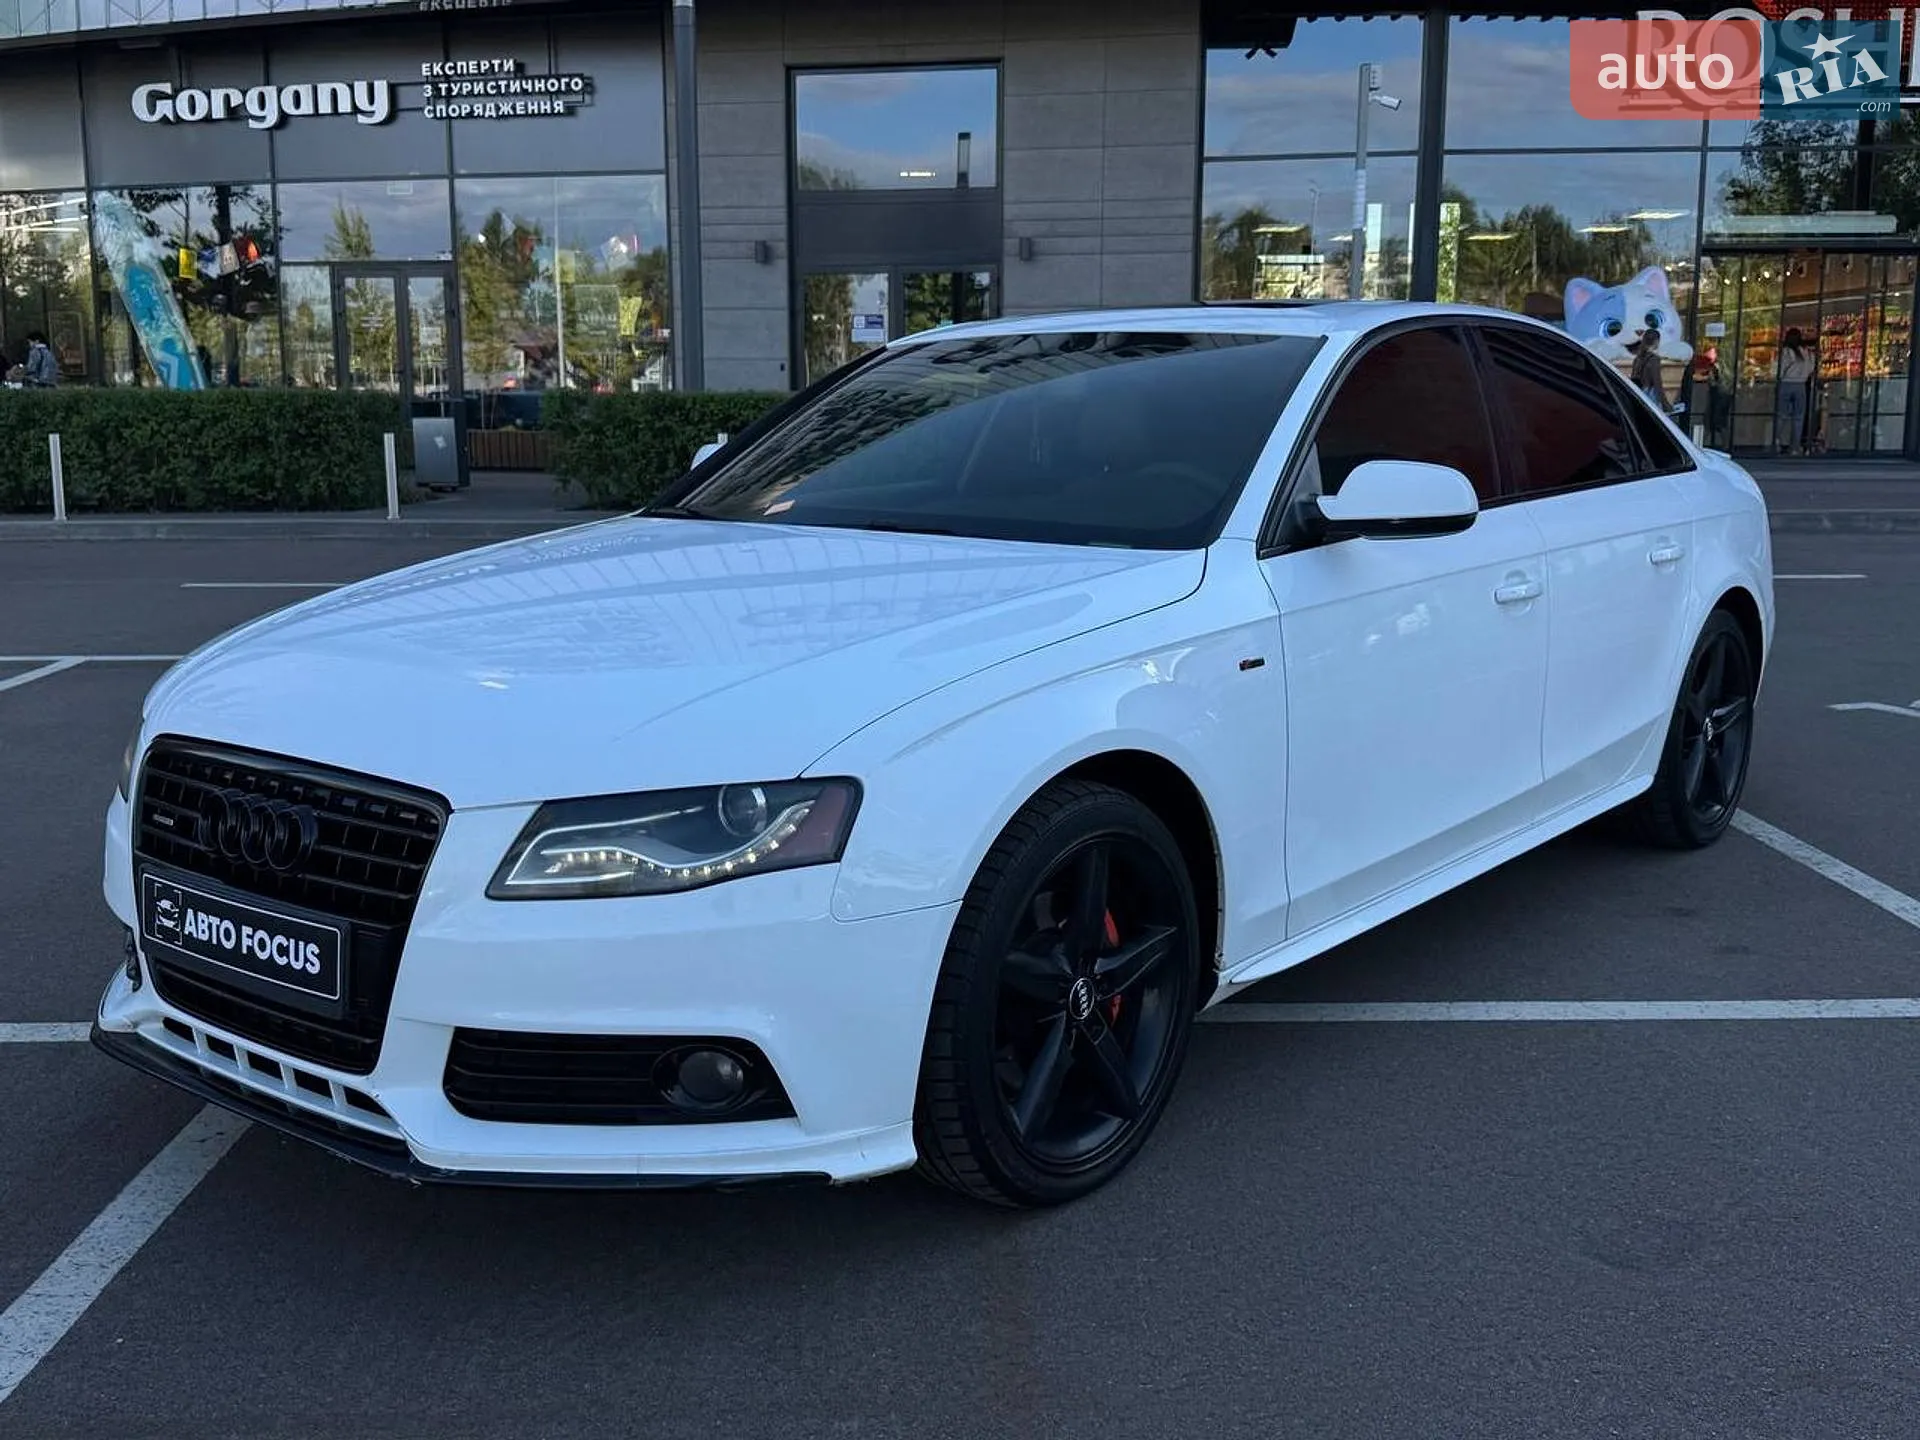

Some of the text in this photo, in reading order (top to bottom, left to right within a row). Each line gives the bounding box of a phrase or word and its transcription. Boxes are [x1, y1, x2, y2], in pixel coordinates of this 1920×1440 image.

[421, 58, 516, 77] ЕКСПЕРТИ
[438, 76, 584, 97] ТУРИСТИЧНОГО
[131, 79, 390, 129] Gorgany
[424, 100, 566, 119] СПОРЯДЖЕННЯ
[184, 907, 322, 975] АВТО FOCUS
